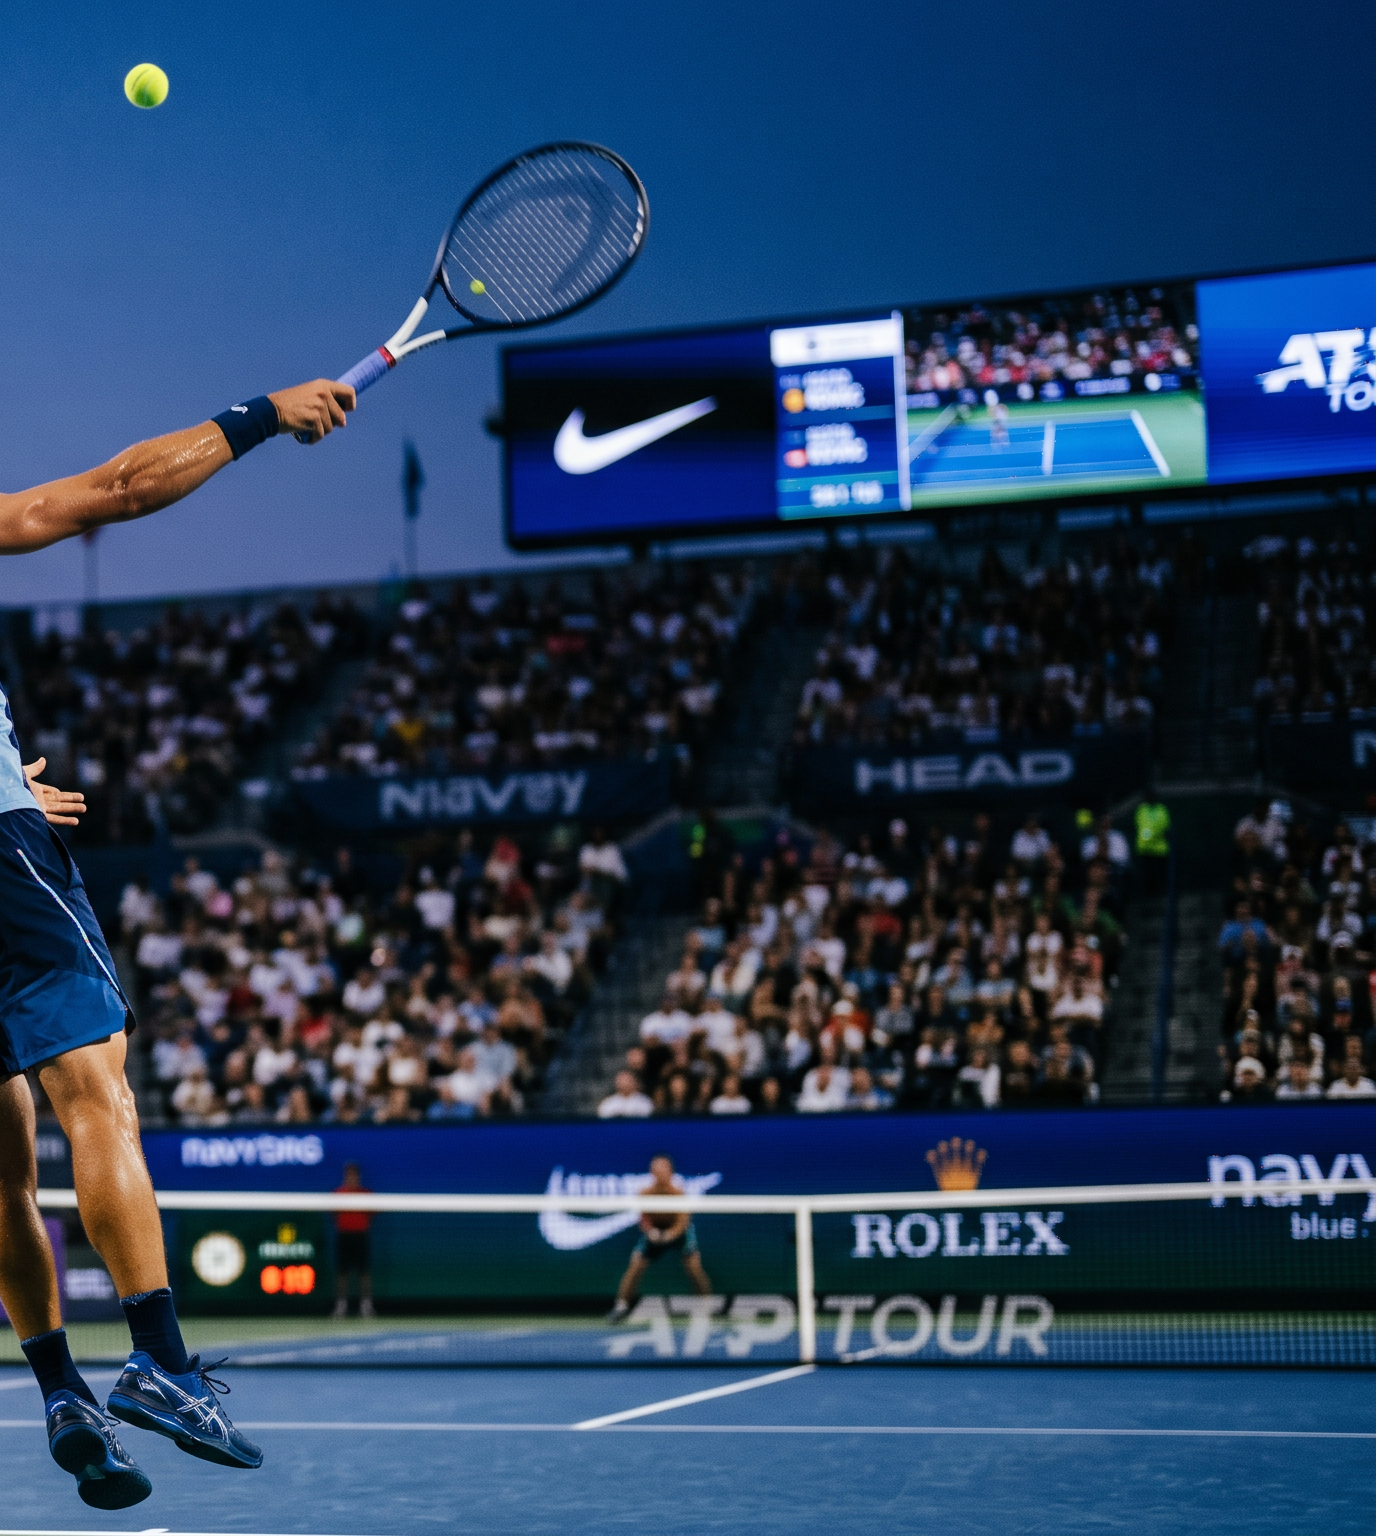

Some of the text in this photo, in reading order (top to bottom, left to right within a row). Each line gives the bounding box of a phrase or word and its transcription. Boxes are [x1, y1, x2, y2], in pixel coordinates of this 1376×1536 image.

[854, 751, 1075, 795] HEAD
[851, 1211, 1071, 1258] ROLEX
[825, 1295, 1055, 1357] TOUR
